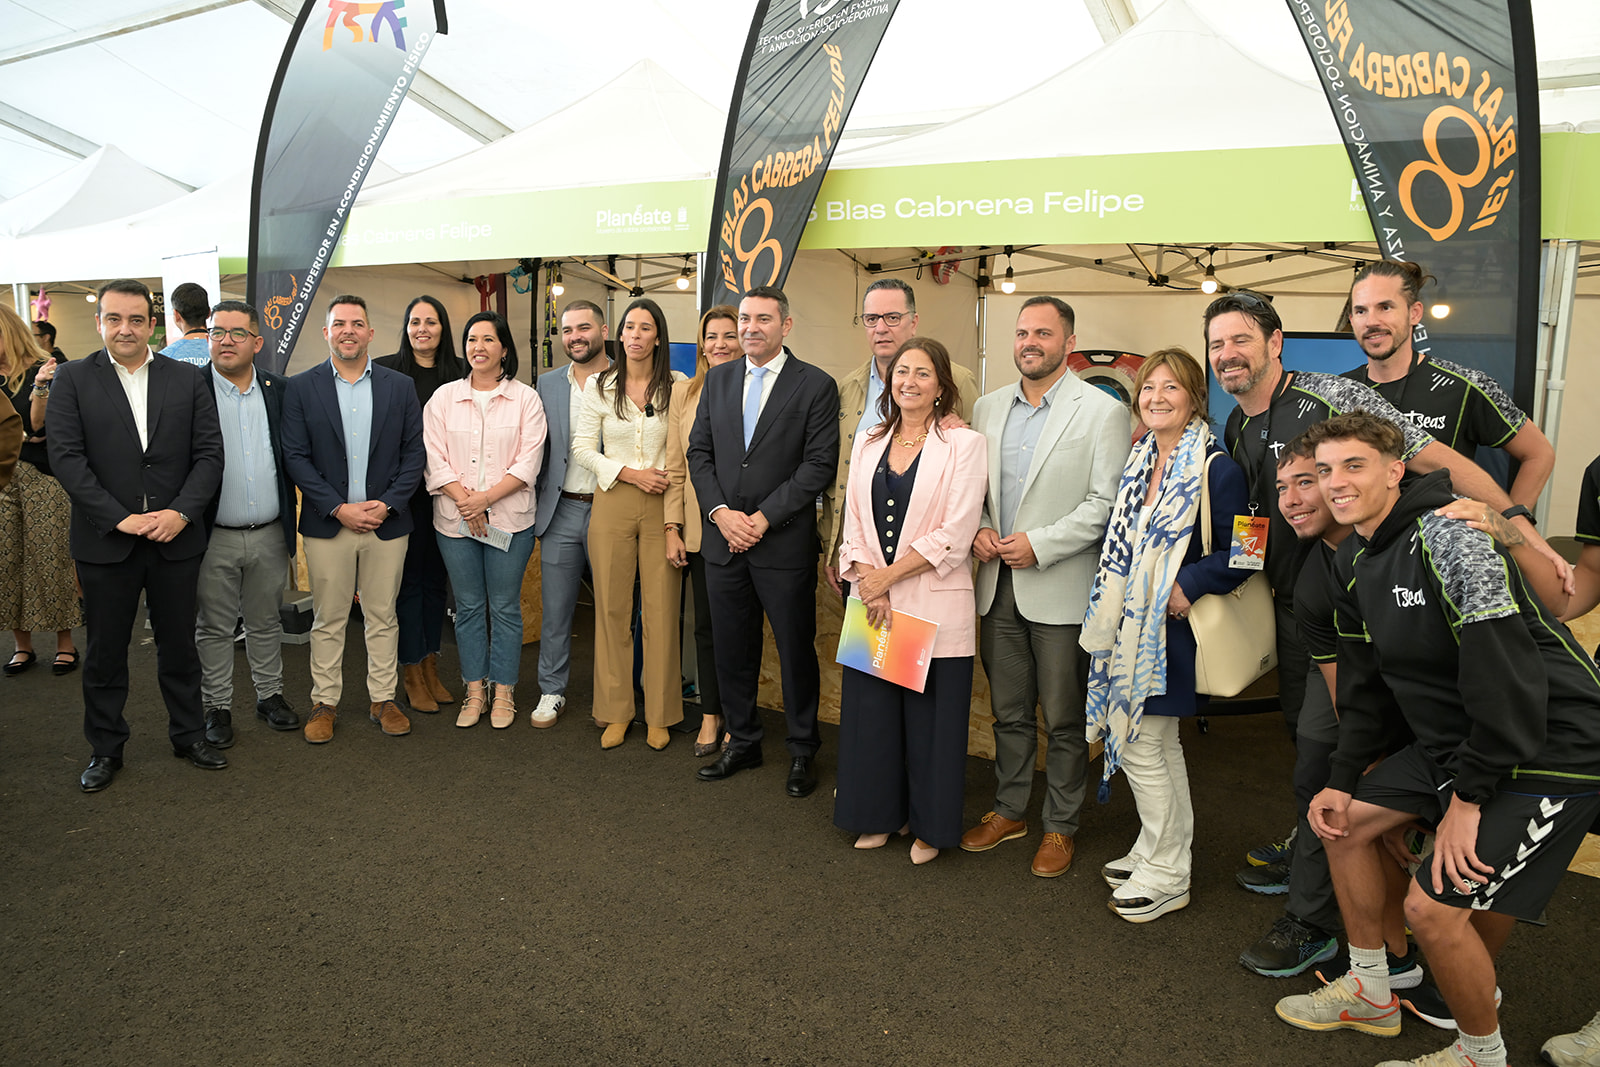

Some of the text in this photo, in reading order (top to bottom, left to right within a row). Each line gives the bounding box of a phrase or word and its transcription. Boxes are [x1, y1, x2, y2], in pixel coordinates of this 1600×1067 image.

[822, 43, 846, 151] FELIPE
[751, 135, 824, 194] CABRERA
[277, 32, 430, 355] TÉCNICO SUPERIOR EN ACONDICIONAMIENTO FÍSICO
[596, 203, 672, 227] Planéate
[720, 174, 749, 249] BLAS
[826, 200, 886, 221] Blas
[894, 194, 1034, 218] Cabrera
[1043, 189, 1145, 218] Felipe
[439, 221, 493, 242] Felipe
[720, 250, 741, 295] IES
